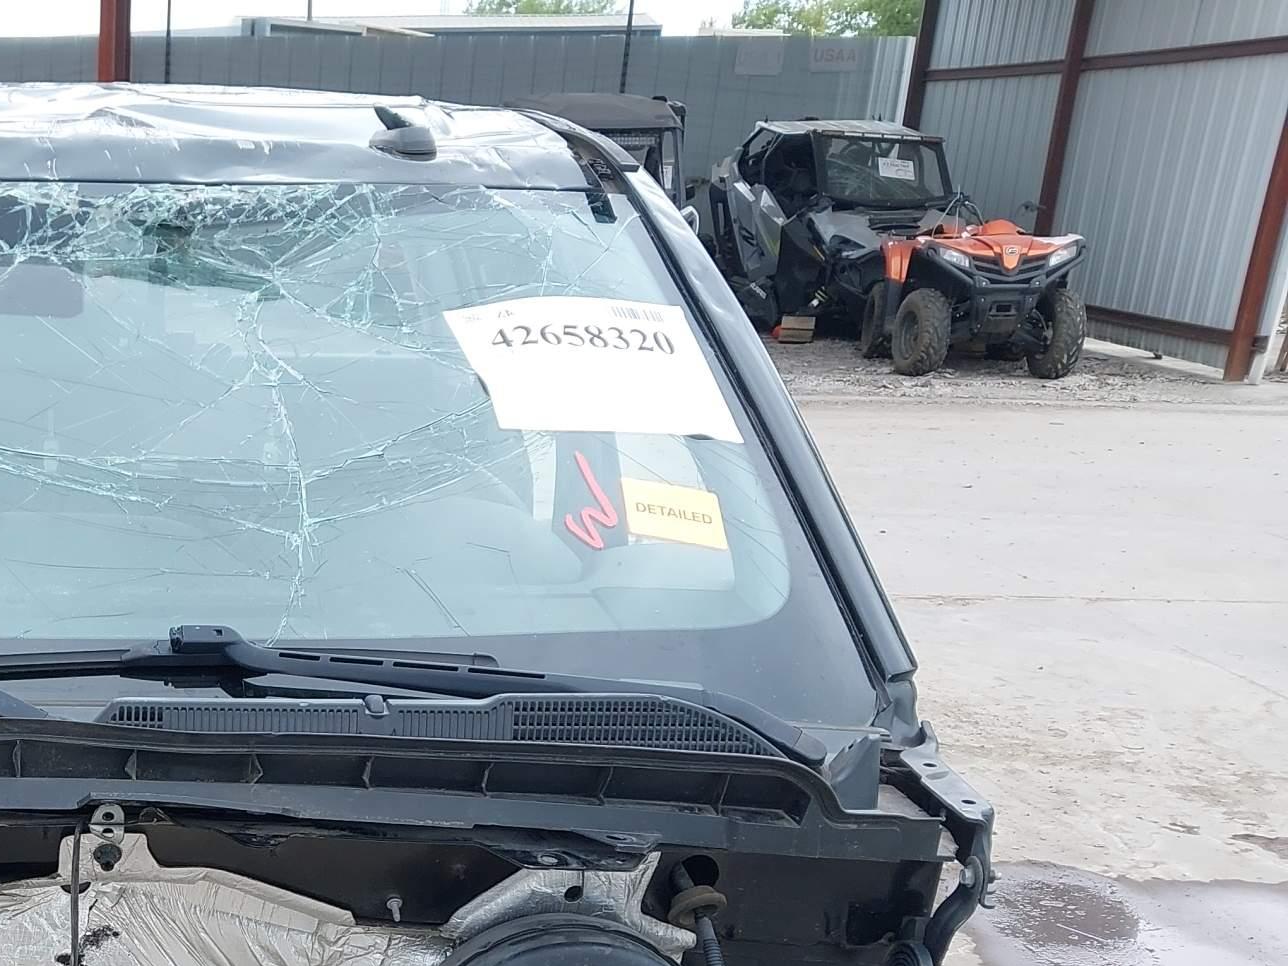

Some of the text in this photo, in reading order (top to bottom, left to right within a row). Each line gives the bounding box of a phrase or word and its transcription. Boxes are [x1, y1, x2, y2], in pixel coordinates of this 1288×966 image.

[814, 47, 857, 63] USAA
[491, 324, 675, 355] 42658320
[635, 502, 713, 524] DETAILED
